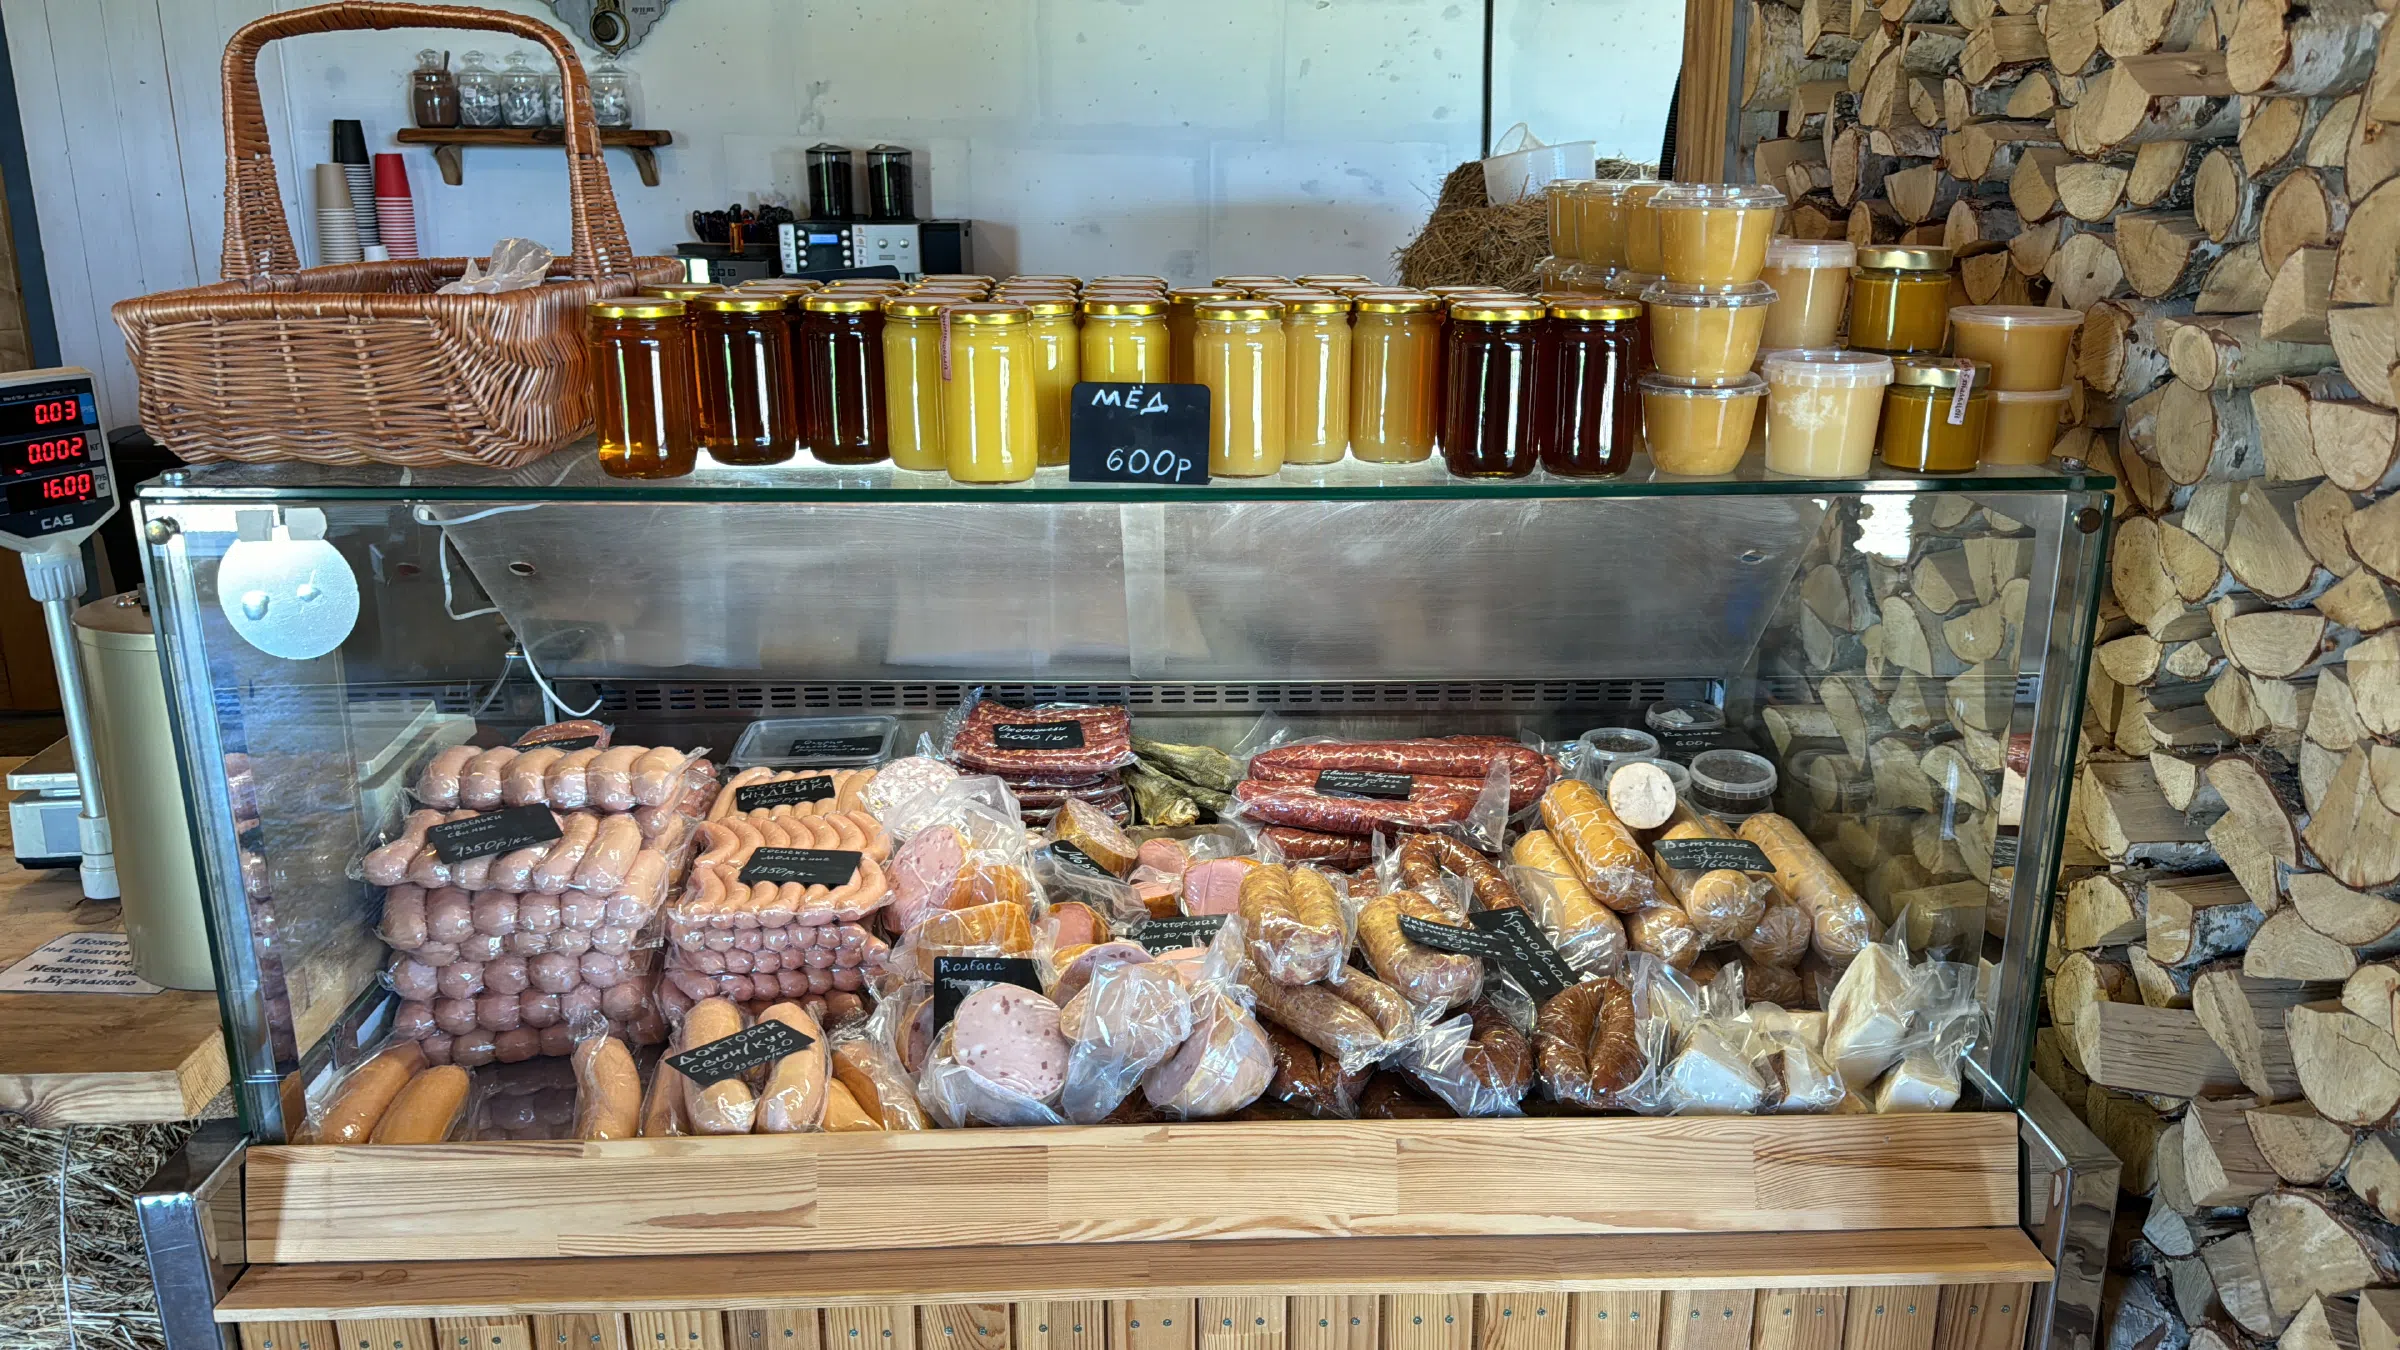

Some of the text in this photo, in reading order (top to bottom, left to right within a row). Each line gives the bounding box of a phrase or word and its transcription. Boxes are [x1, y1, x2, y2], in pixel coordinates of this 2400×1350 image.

[35, 400, 77, 425] 0.03
[1091, 385, 1169, 415] МЁД
[28, 437, 83, 464] 0.002
[43, 474, 91, 499] 16.00
[41, 514, 74, 530] CAS
[940, 959, 1007, 974] Колбаса
